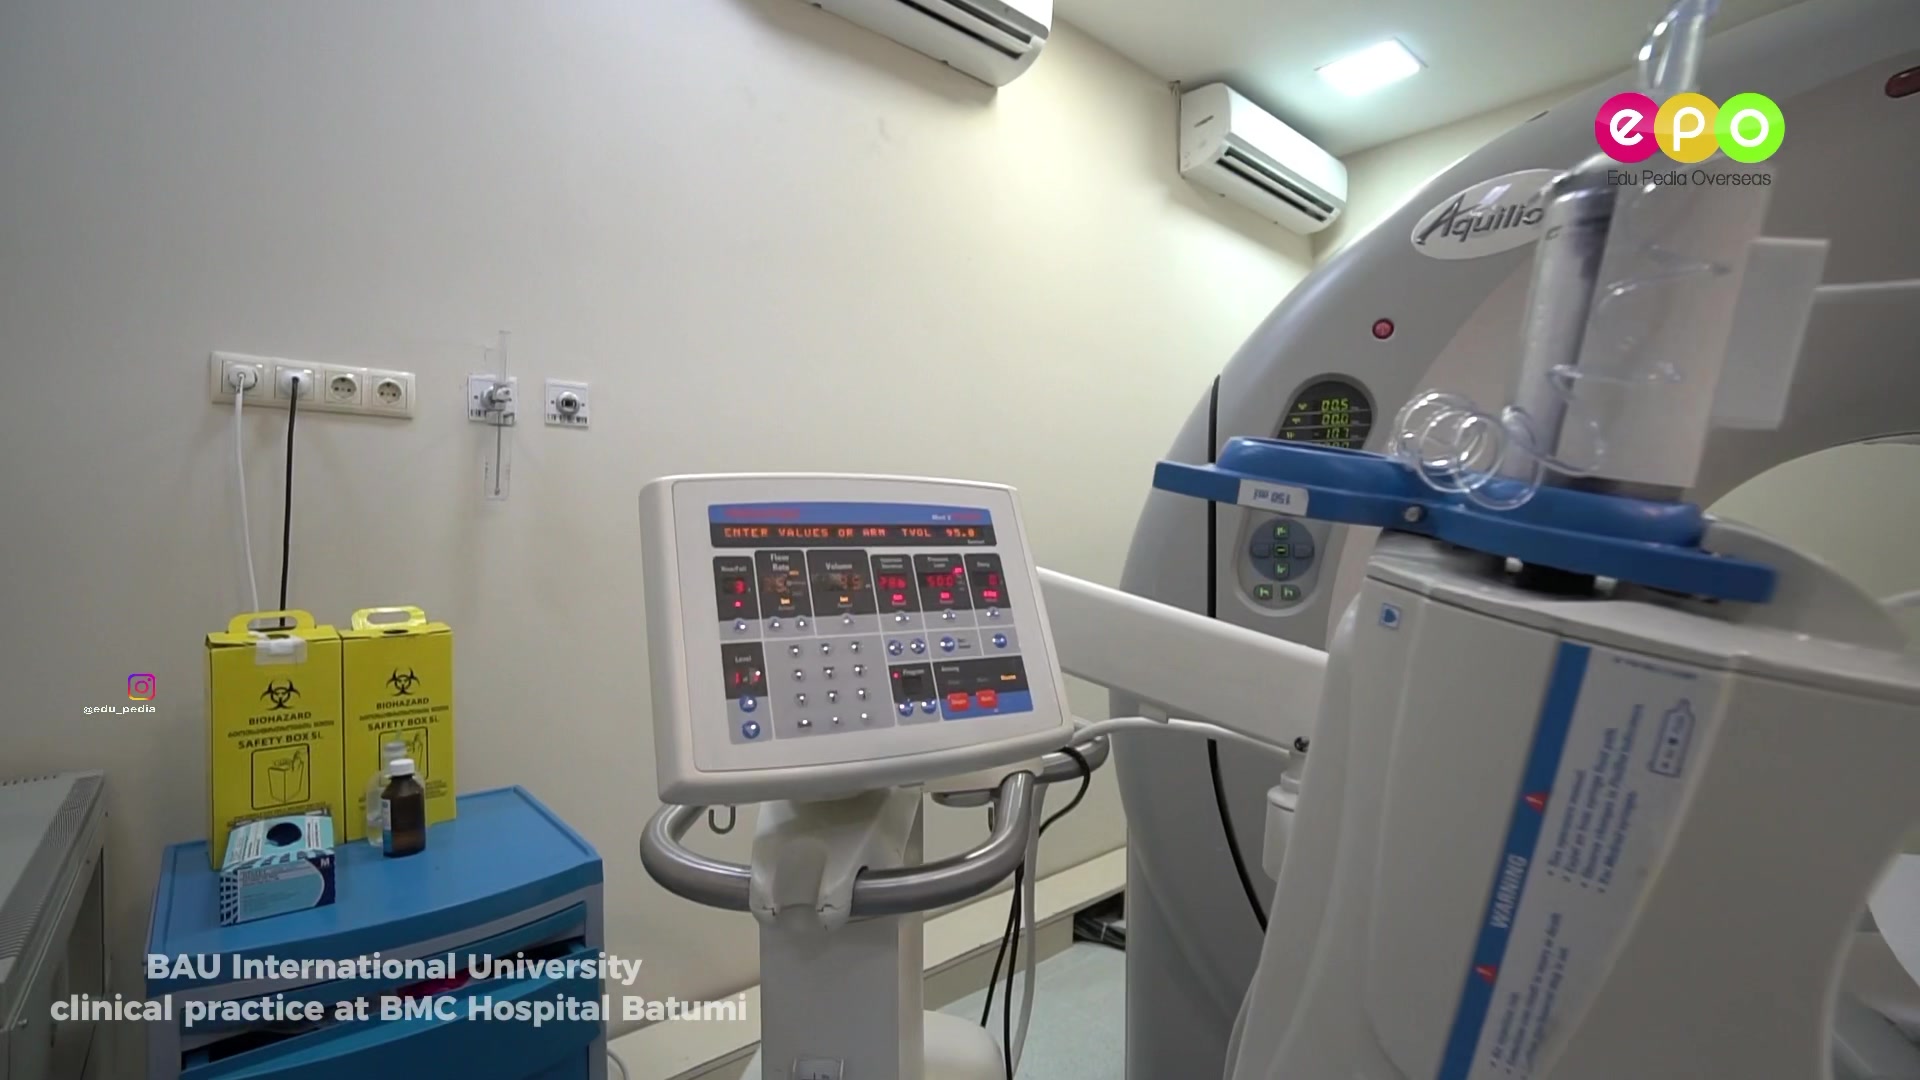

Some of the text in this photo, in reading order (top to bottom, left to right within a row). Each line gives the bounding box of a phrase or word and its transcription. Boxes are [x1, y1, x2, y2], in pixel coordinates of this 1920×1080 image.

[1416, 193, 1545, 246] Aquilio
[1271, 491, 1291, 505] 150
[723, 527, 769, 538] ENTER
[778, 527, 829, 538] VALUES
[838, 528, 854, 538] OR
[862, 528, 886, 537] ARM
[901, 528, 932, 538] TVOL
[377, 698, 429, 710] BIOHAZARD
[249, 711, 312, 725] BIOHAZARD
[368, 719, 404, 731] SAFETY
[407, 716, 428, 727] BOX
[238, 736, 283, 750] SAFETY
[285, 733, 309, 743] BOX
